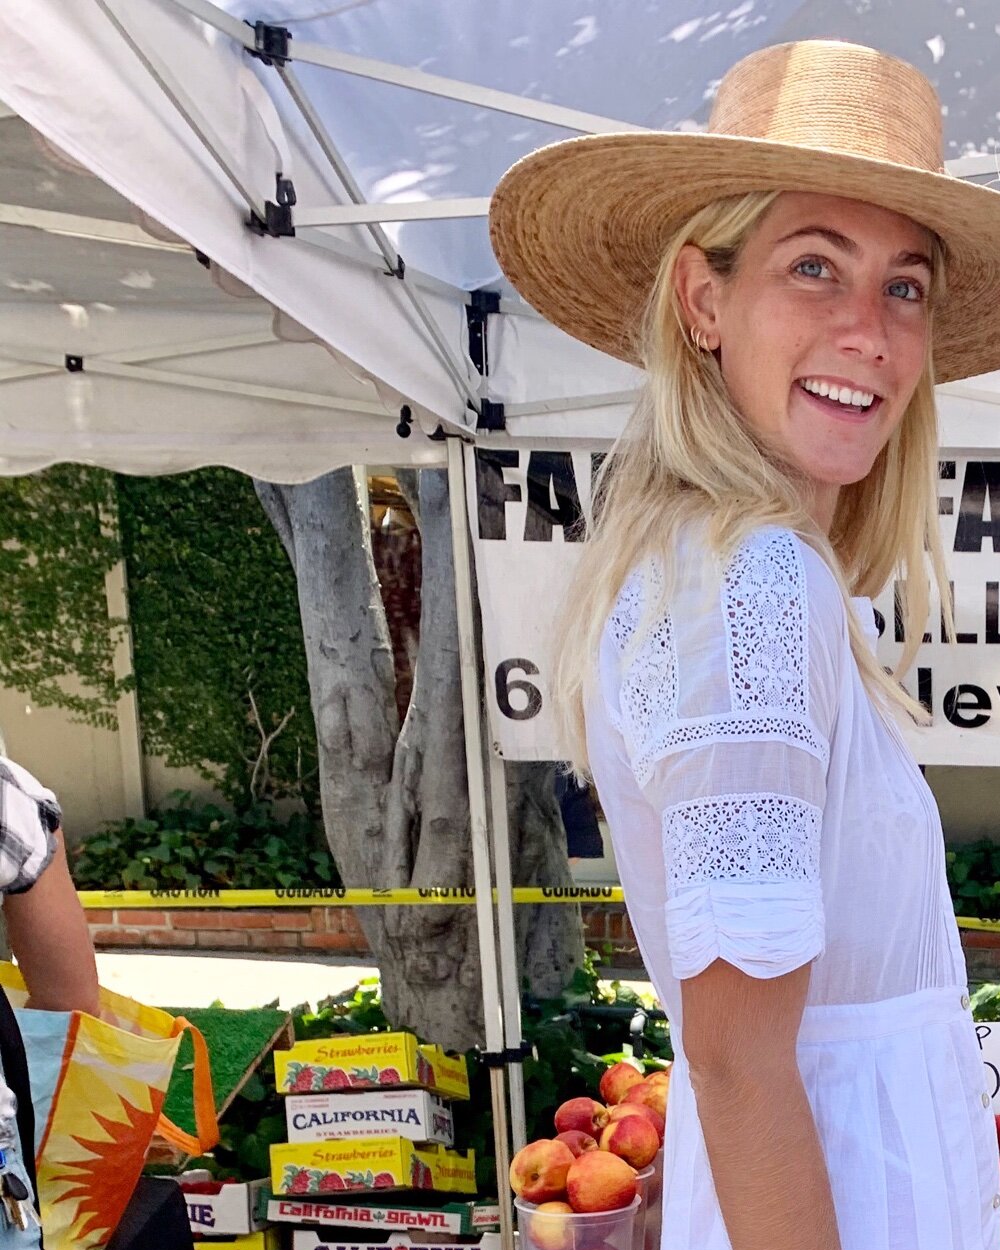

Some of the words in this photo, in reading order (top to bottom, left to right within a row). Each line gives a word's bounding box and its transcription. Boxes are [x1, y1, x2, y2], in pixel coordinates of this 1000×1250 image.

[314, 1043, 401, 1063] Strawberries
[292, 1108, 422, 1130] CALIFORNIA
[310, 1149, 398, 1167] Strawberries
